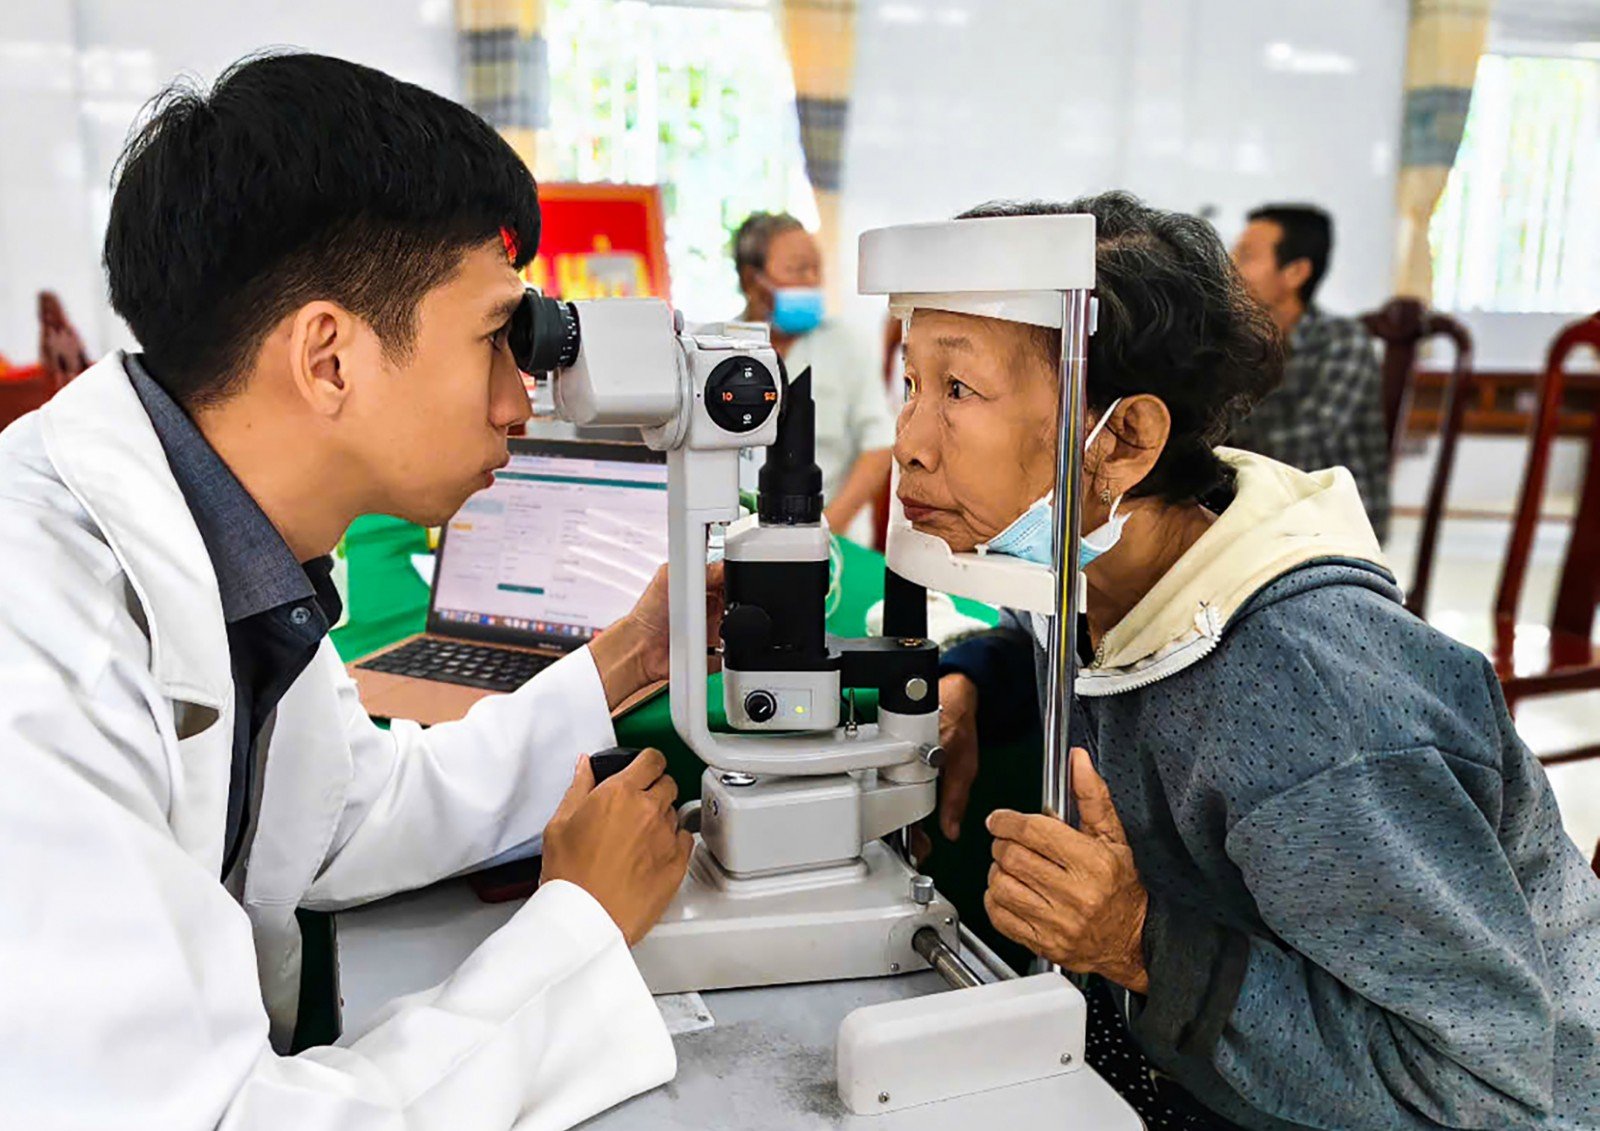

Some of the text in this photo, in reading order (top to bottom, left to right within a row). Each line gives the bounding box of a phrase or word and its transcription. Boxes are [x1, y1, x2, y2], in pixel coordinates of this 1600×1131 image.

[744, 367, 753, 378] 16
[722, 392, 733, 401] 10
[743, 413, 752, 424] 16
